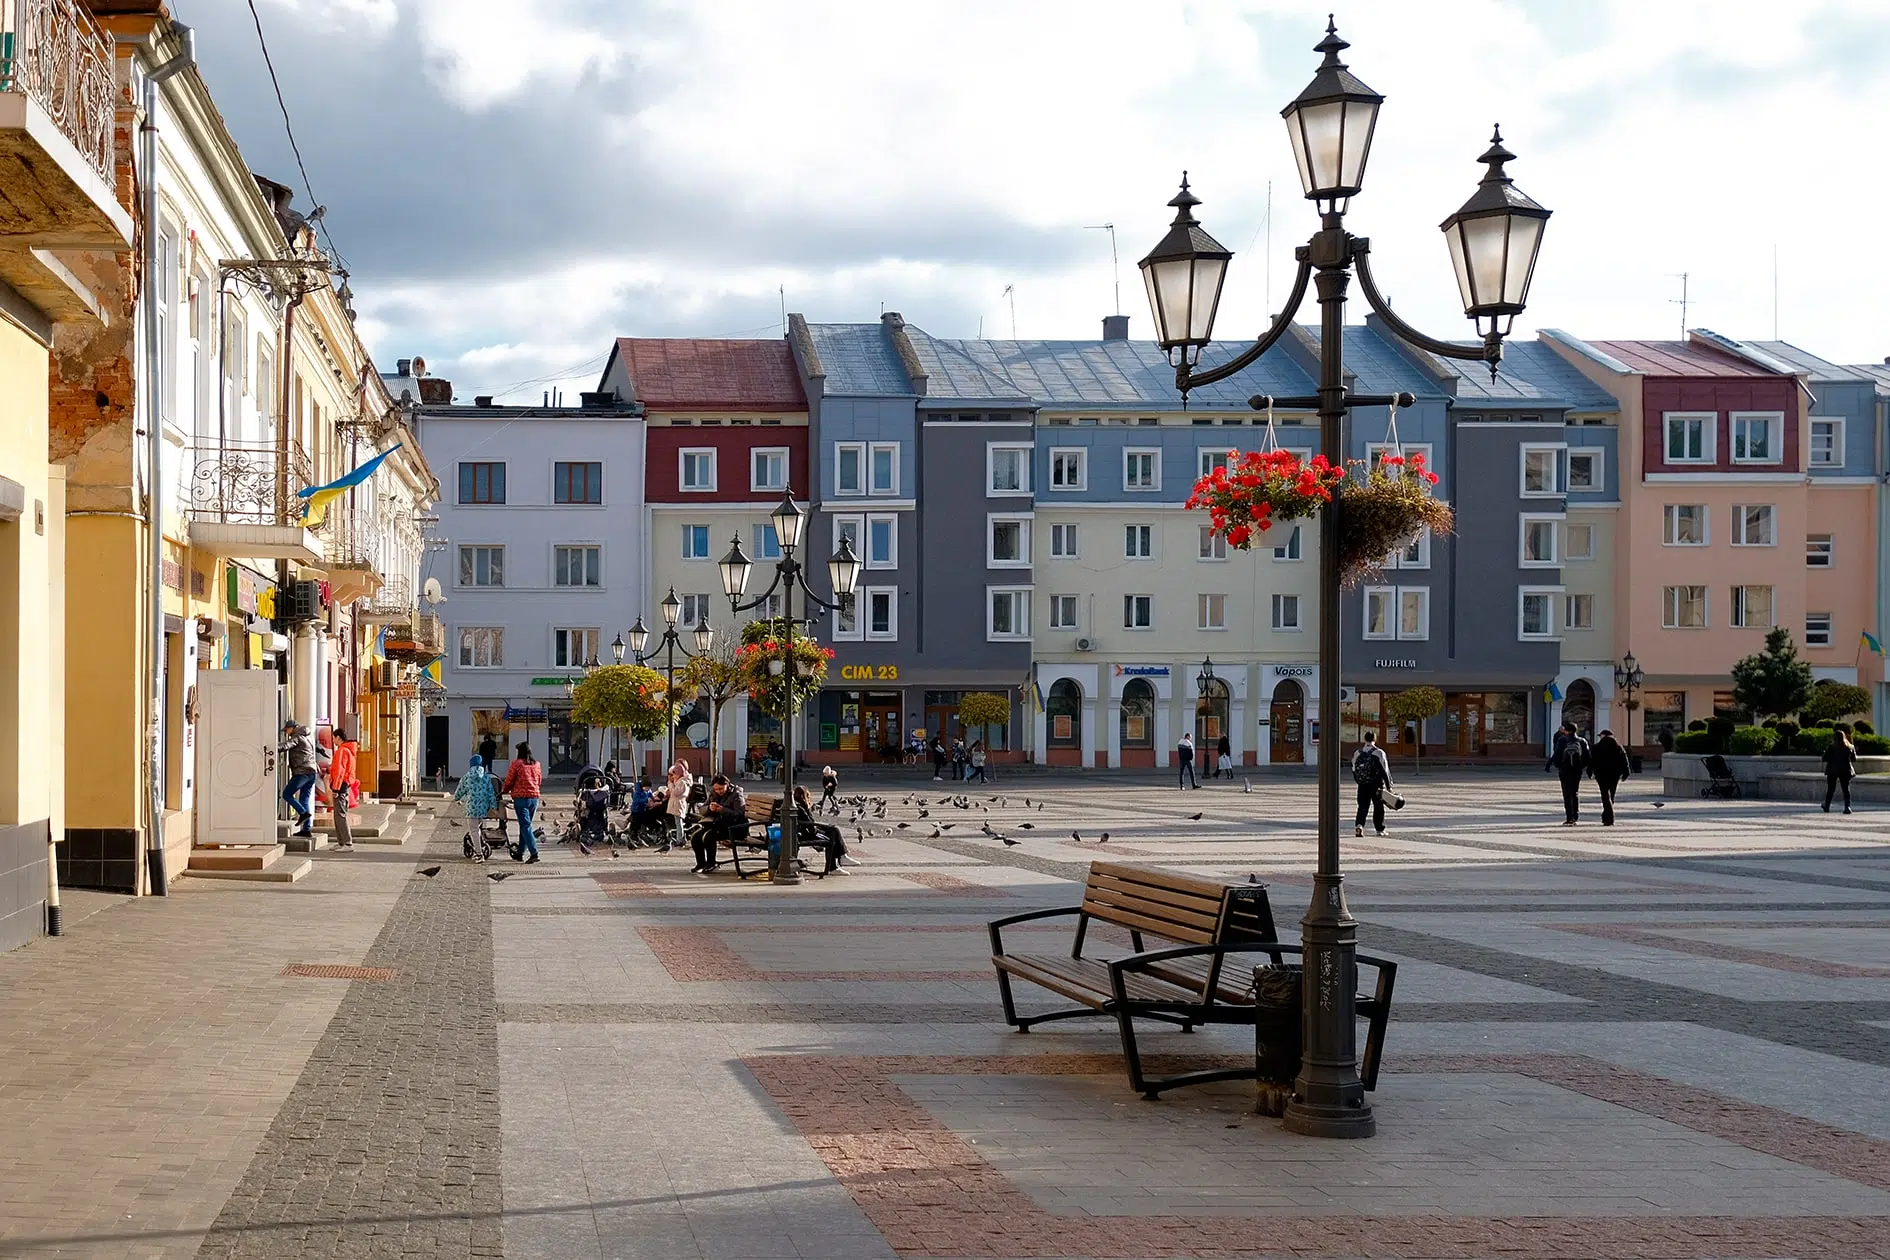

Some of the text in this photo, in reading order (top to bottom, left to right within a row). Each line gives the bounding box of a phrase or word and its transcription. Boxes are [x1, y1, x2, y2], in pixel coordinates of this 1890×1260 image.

[1375, 659, 1416, 668] FUJIFILM
[878, 665, 898, 679] 23
[1275, 666, 1313, 677] Vapors
